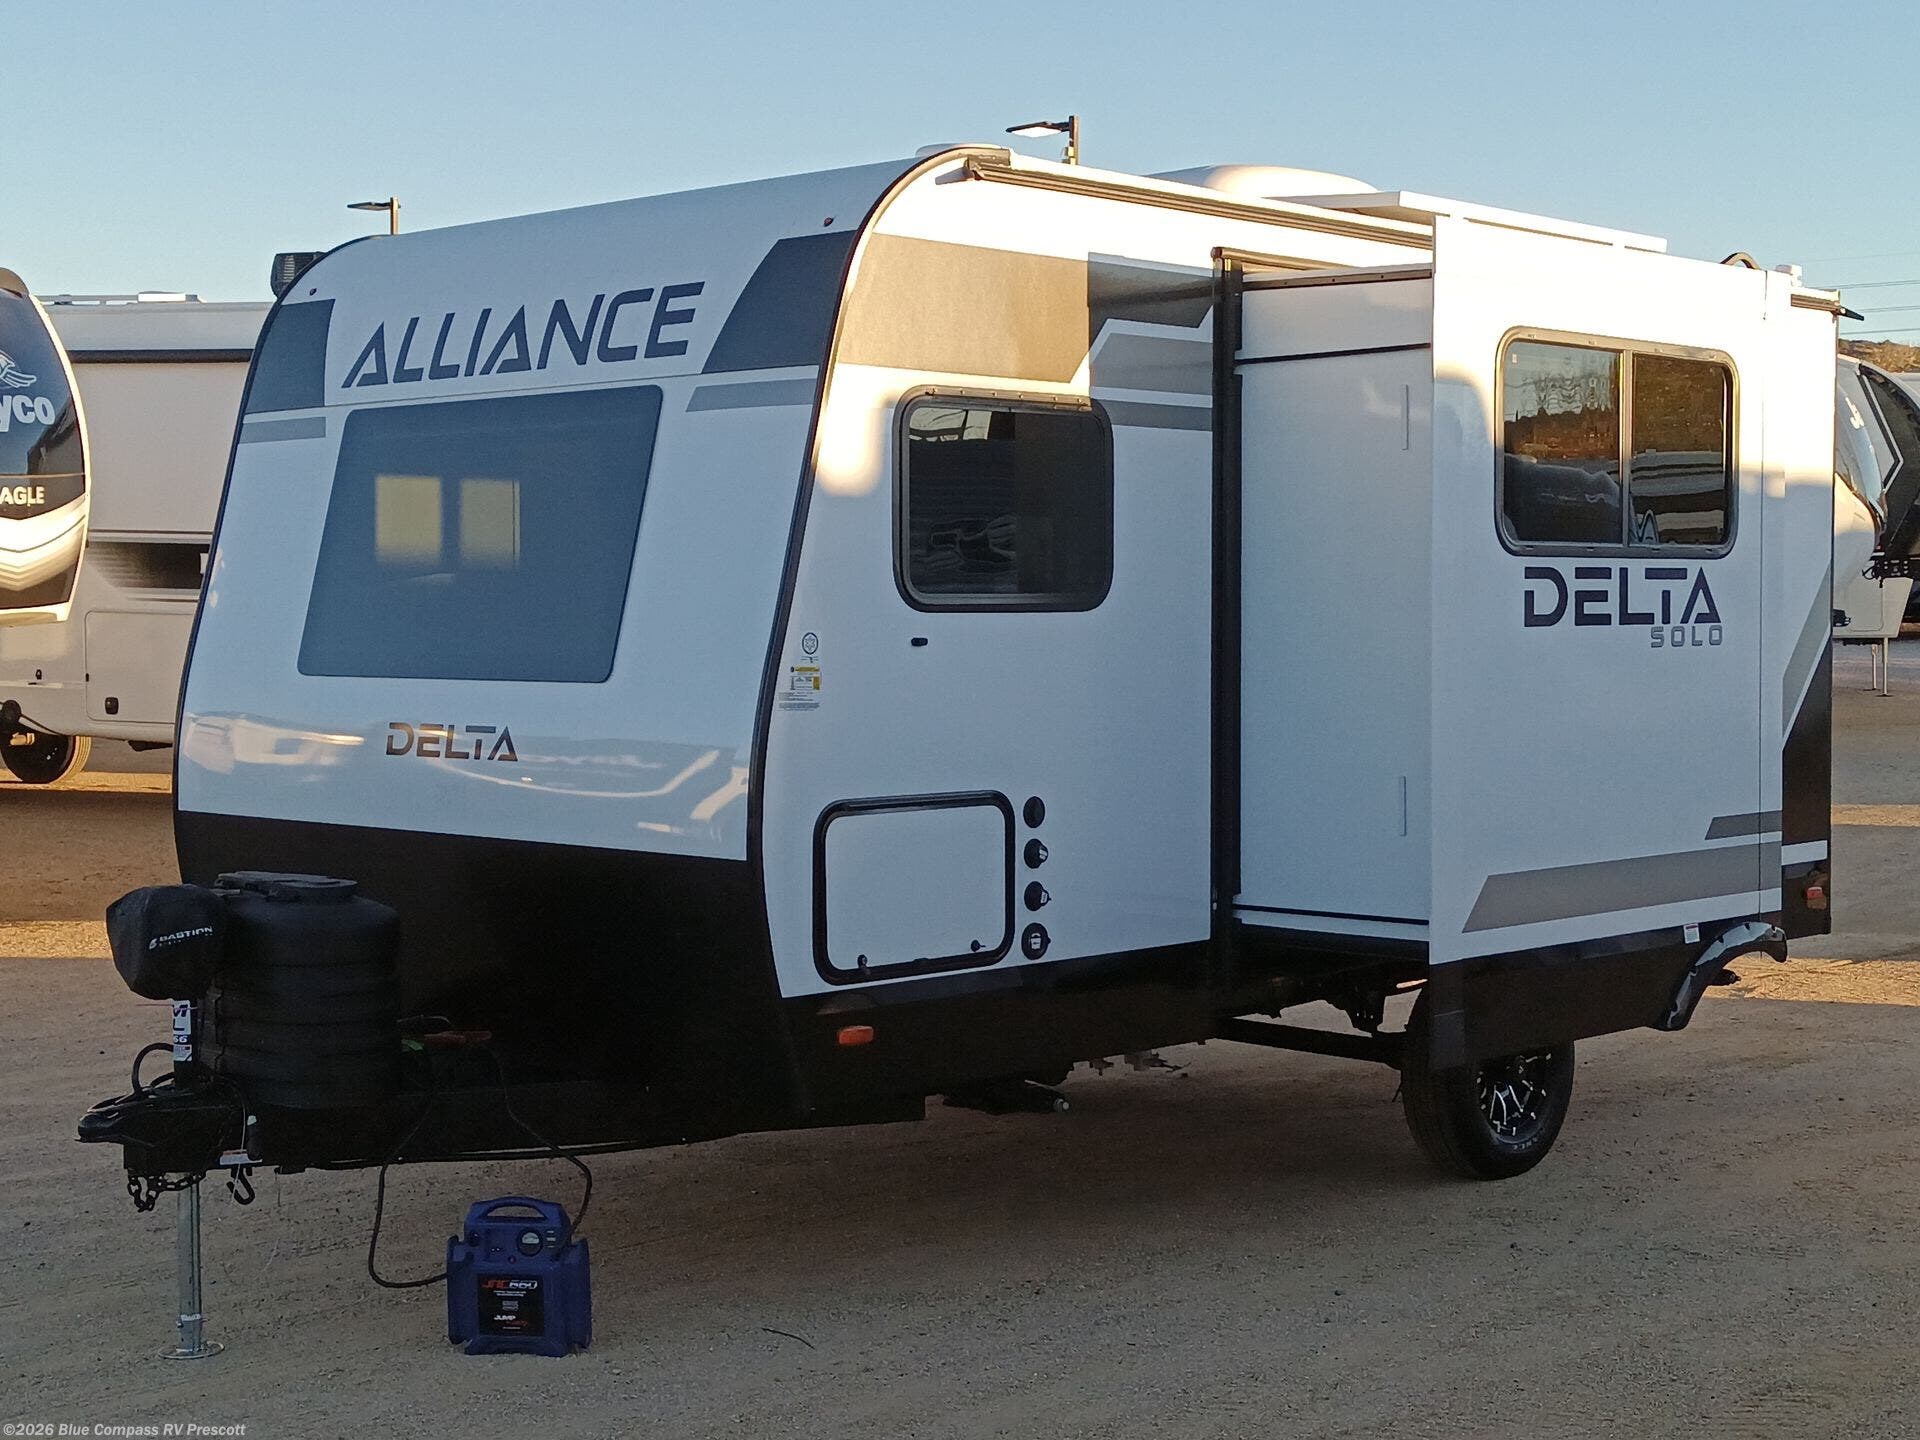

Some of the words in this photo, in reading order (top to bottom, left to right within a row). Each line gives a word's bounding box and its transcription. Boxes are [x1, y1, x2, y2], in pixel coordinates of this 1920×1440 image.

[341, 281, 705, 388] ALLIANCE
[1524, 567, 1721, 627] DELTA
[1651, 625, 1723, 648] SOLO
[386, 722, 518, 762] DELTA
